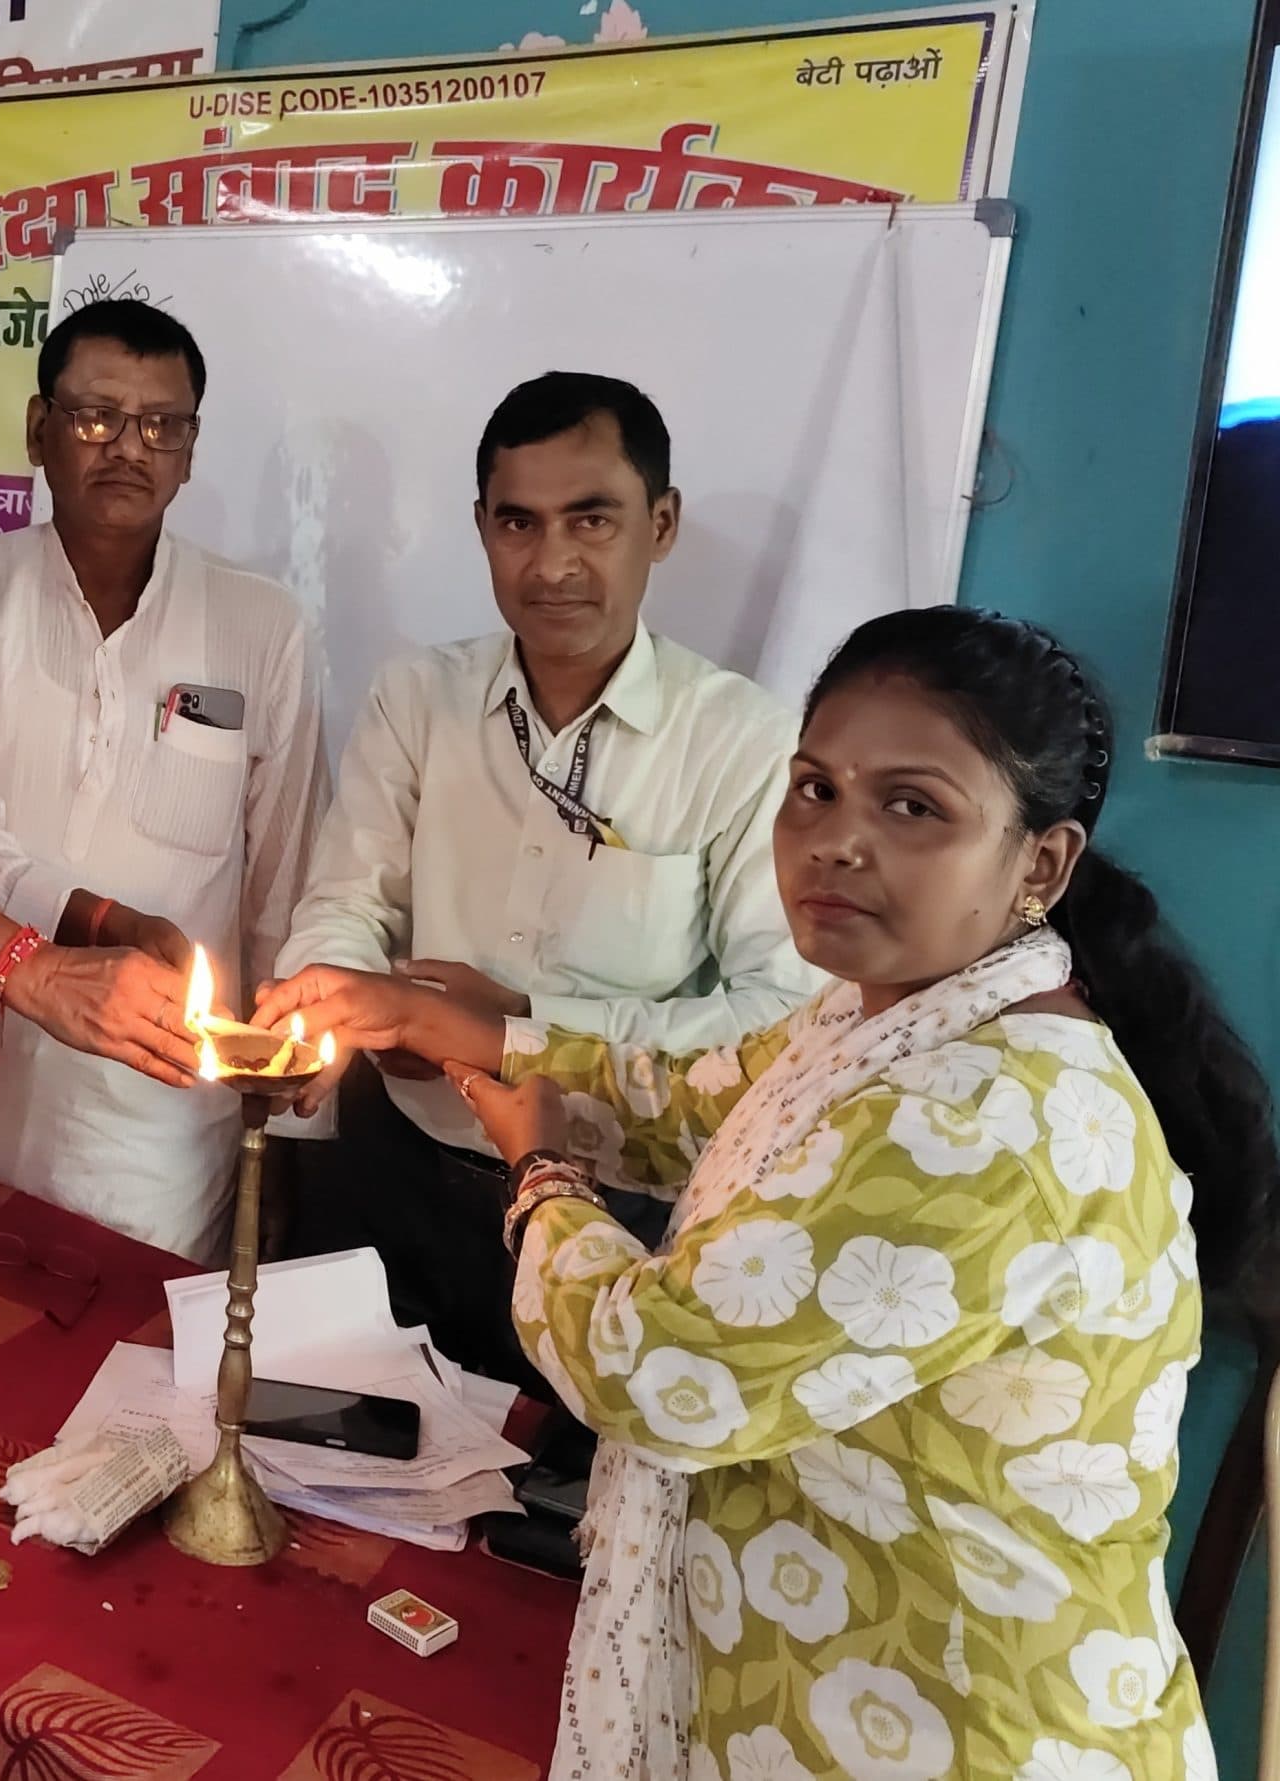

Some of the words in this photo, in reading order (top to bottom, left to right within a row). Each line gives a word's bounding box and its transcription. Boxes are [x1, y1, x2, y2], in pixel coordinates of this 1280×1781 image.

[796, 56, 845, 86] बेटी
[190, 90, 272, 119] U-DISE
[281, 71, 546, 114] CODE-10351200107
